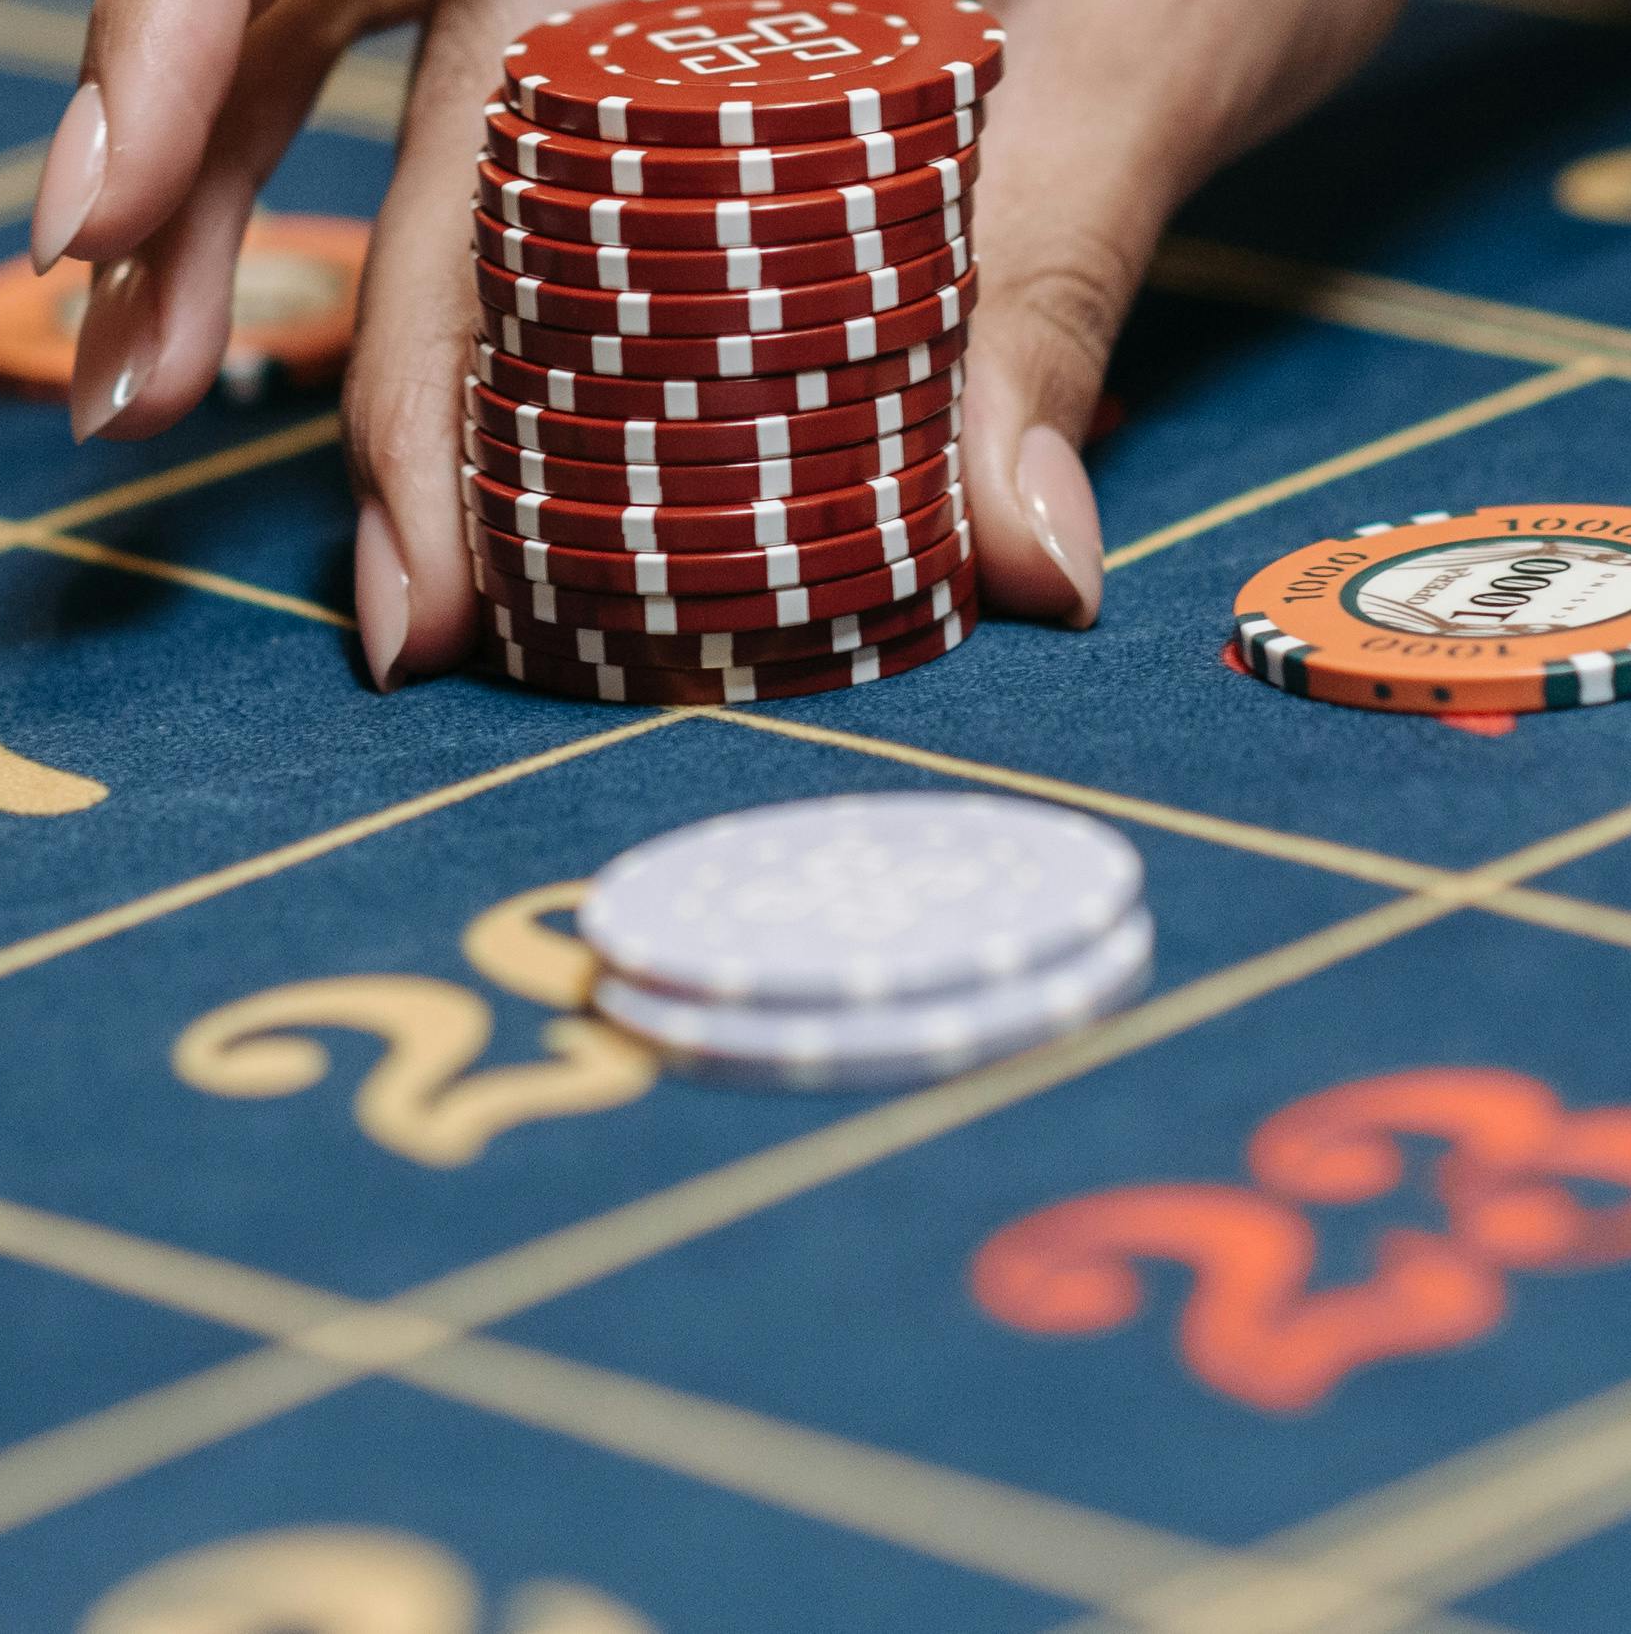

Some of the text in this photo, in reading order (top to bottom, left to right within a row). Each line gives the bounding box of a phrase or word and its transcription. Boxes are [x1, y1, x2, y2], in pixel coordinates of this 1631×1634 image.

[1283, 552, 1367, 603] 1000
[1407, 567, 1472, 605] OPERA
[1450, 558, 1571, 622] 1000
[1550, 572, 1616, 619] CASINO
[1361, 636, 1514, 657] 1000
